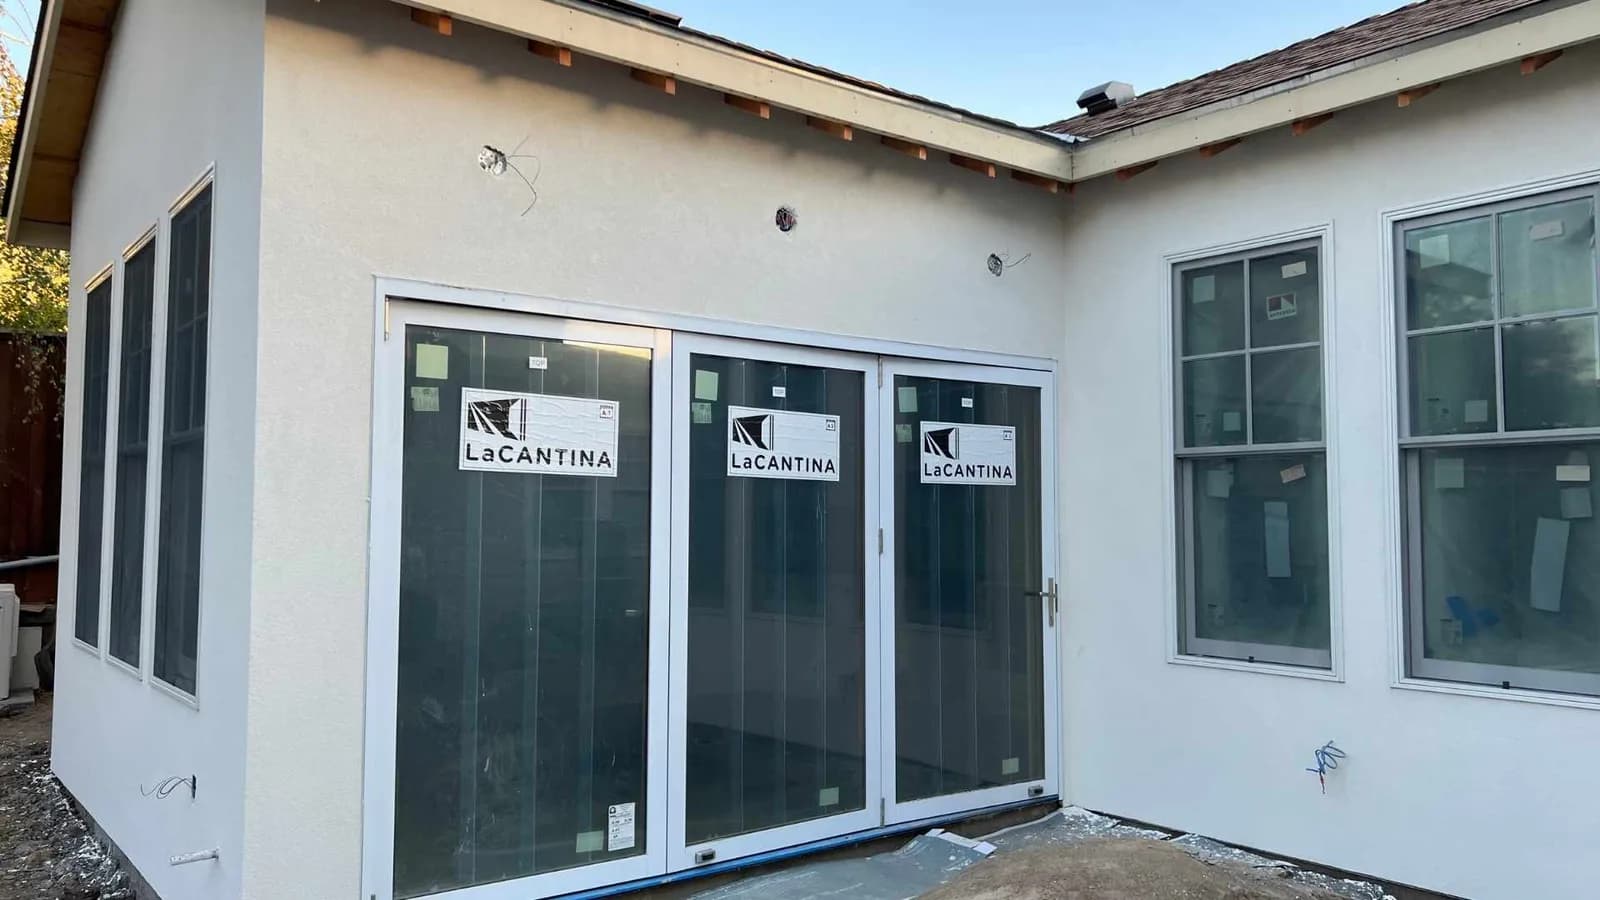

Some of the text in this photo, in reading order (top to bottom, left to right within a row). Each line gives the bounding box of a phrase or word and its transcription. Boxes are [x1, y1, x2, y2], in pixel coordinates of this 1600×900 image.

[466, 442, 612, 469] LaCANTINA
[732, 452, 836, 474] LaCANTINA
[924, 463, 1013, 479] LaCANTINA
